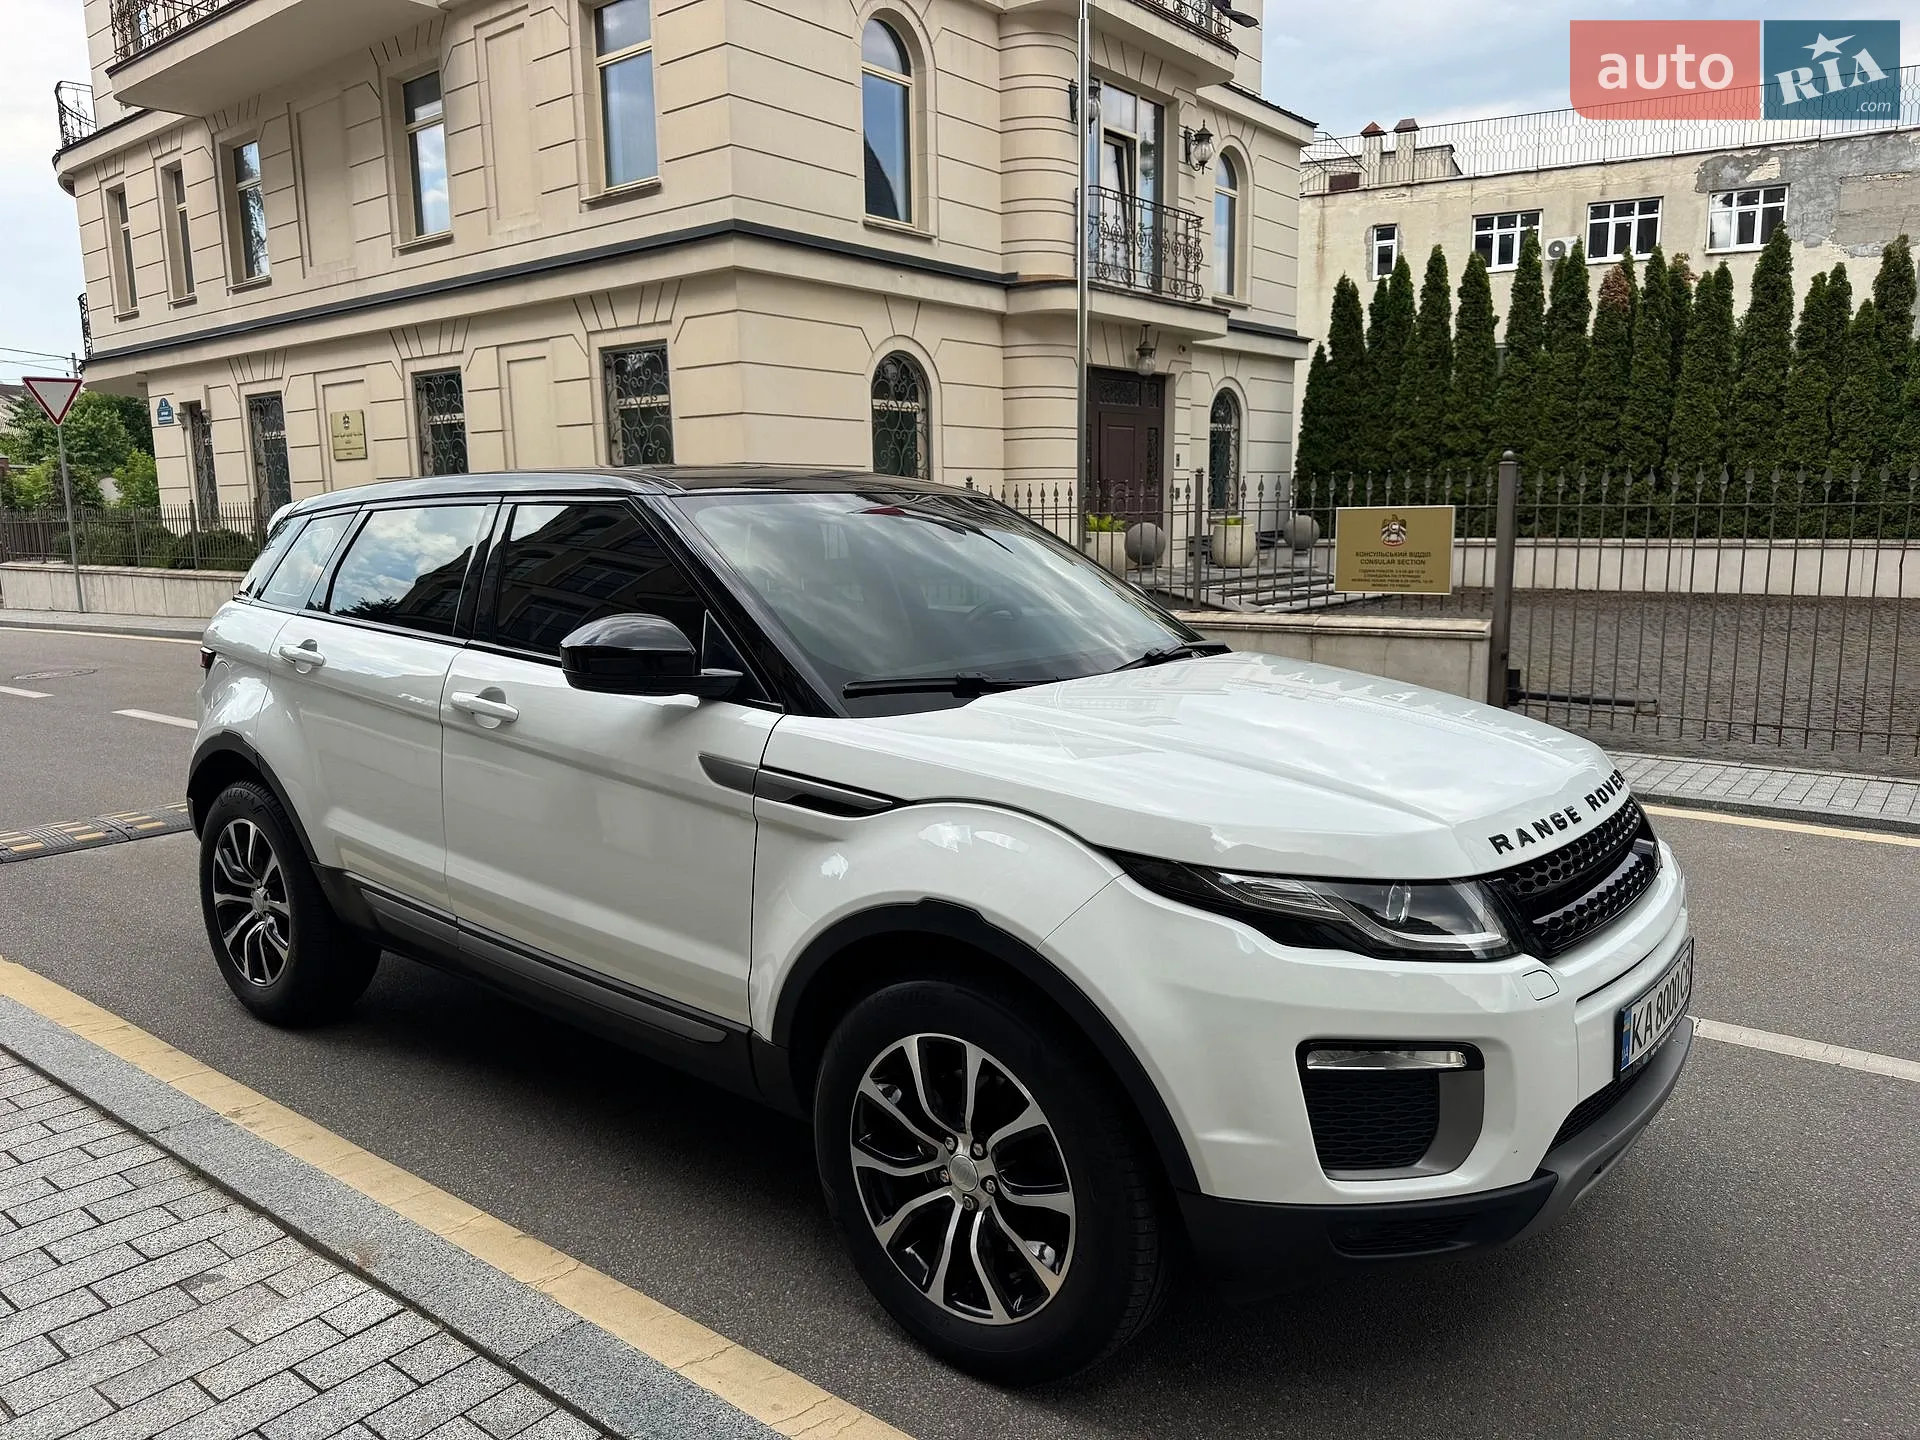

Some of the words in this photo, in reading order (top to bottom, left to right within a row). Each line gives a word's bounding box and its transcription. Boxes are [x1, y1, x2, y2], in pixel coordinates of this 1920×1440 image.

[1488, 805, 1582, 855] RANGE
[1584, 768, 1626, 812] ROVER
[1631, 1000, 1653, 1055] KA
[1655, 970, 1680, 1032] 8000
